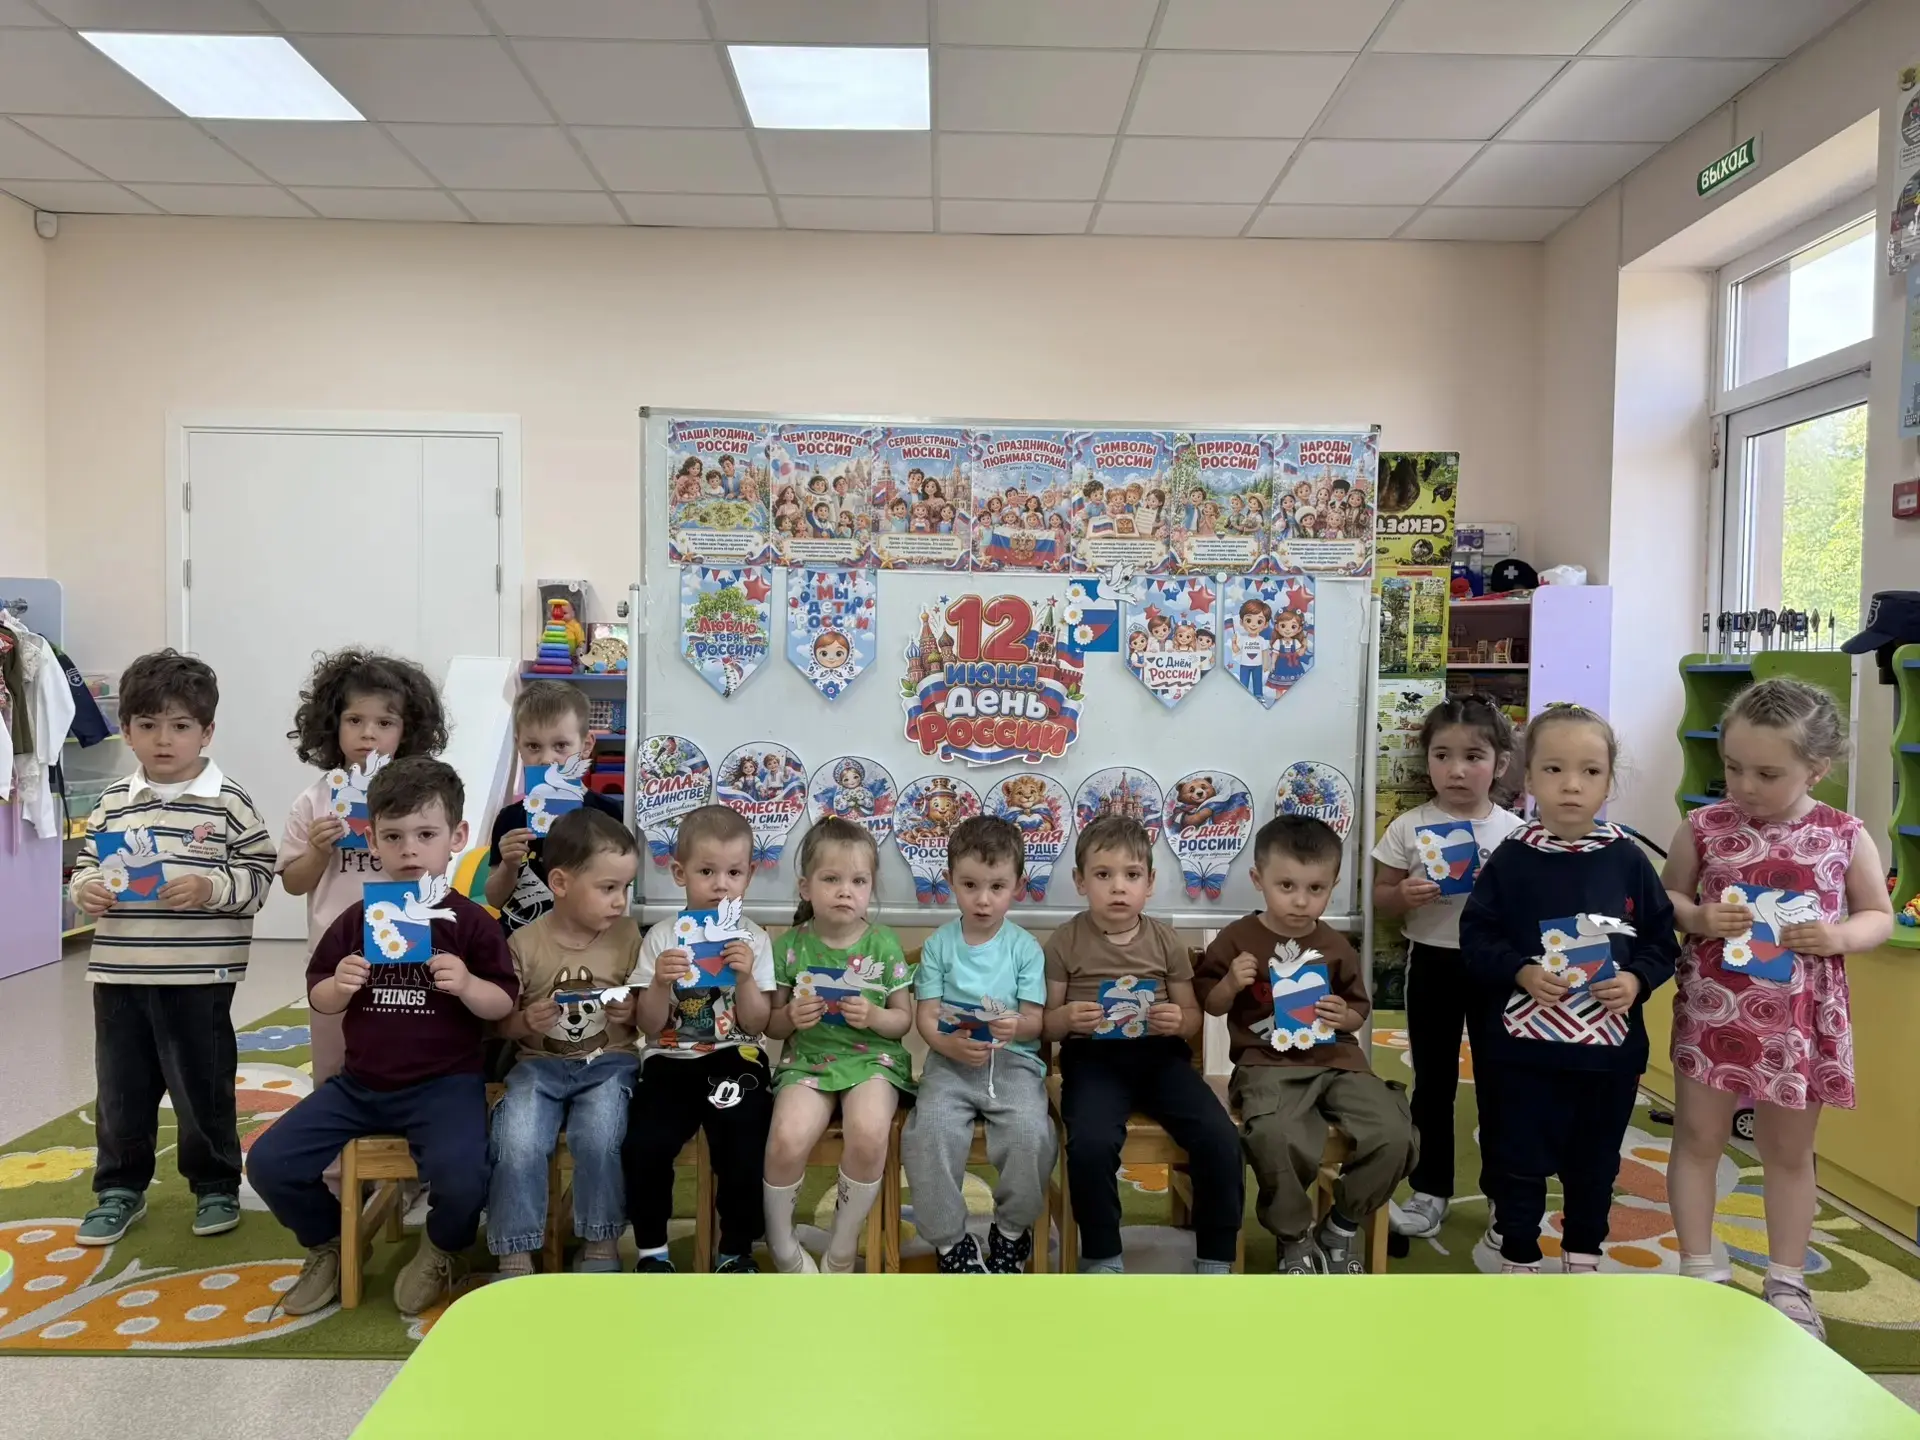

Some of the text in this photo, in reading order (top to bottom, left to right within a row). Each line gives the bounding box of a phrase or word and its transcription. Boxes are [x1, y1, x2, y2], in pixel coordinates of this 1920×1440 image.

[1701, 144, 1749, 190] ВЫХОД
[679, 427, 710, 441] НАША
[713, 427, 755, 442] РОДИНА
[783, 431, 863, 446] ЧЕМ ГОРДИТСЯ
[888, 435, 921, 448] СЕРДЦЕ
[923, 435, 958, 448] СТРАНЫ
[696, 440, 748, 454] РОССИЯ
[797, 442, 852, 457] РОССИЯ
[902, 446, 950, 460] МОСКВА
[987, 439, 1065, 456] С ПРАЗДНИКОМ
[1093, 441, 1157, 455] СИМВОЛЫ
[1197, 441, 1260, 457] ПРИРОДА
[1300, 440, 1351, 453] НАРОДЫ
[983, 452, 1067, 470] ЛЮБИМАЯ СТРАНА
[1096, 454, 1153, 469] РОССИИ
[1200, 455, 1257, 470] РОССИИ
[1299, 452, 1351, 466] РОССИИ
[1376, 518, 1445, 534] СЕКРЕТ
[816, 584, 849, 600] Мы
[795, 613, 869, 630] России
[945, 594, 1033, 663] 12
[1156, 655, 1192, 669] С Днём
[1149, 668, 1198, 681] России!
[944, 686, 1049, 721] День
[916, 711, 1069, 756] России
[645, 773, 694, 796] СИЛА
[638, 786, 704, 811] В ЕДИНСТВЕ
[730, 799, 791, 815] ВМЕСТЕ
[759, 813, 790, 824] СИЛА
[1023, 829, 1064, 844] ССИЯ
[1180, 821, 1240, 840] С ДНЁМ
[918, 838, 949, 848] ТЕП
[1024, 843, 1059, 855] ЕРДЦЕ
[1178, 838, 1242, 852] РОССИИ!
[339, 847, 383, 873] Fre
[372, 988, 427, 1006] THINGS
